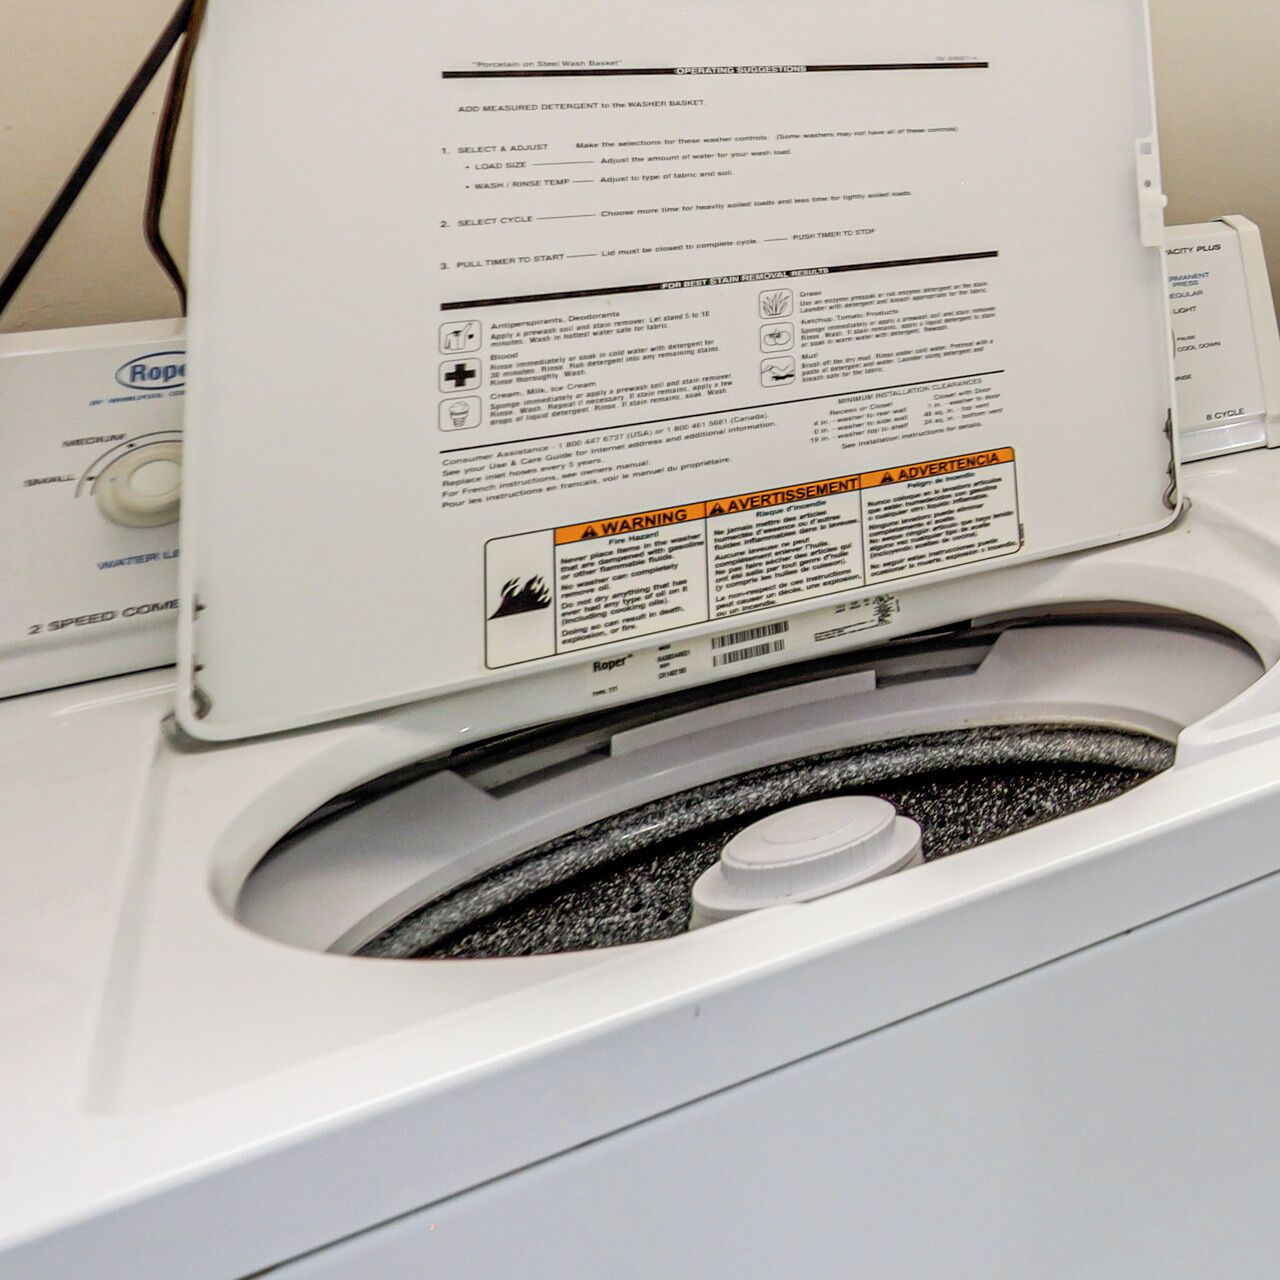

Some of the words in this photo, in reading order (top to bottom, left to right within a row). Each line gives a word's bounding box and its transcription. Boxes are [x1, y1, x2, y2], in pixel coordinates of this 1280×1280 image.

[676, 67, 734, 75] OPERATING
[737, 65, 807, 73] SUGGESTIONS
[457, 145, 497, 154] SELECT
[509, 143, 548, 151] ADJUST
[474, 162, 503, 170] LOAD
[505, 161, 526, 169] SIZE
[543, 178, 570, 186] TEMP
[457, 217, 497, 227] SELECT
[499, 215, 533, 224] CYCLE
[1165, 247, 1194, 255] ACITY
[1196, 243, 1222, 252] PLUS
[456, 260, 483, 268] PULL
[485, 257, 516, 265] TIMER
[533, 253, 564, 262] START
[662, 281, 681, 290] FOR
[684, 279, 707, 288] BEST
[710, 276, 739, 285] STAIN
[742, 271, 790, 282] REMOVAL
[1172, 280, 1199, 288] PRESS
[1172, 305, 1197, 315] LIGHT
[1198, 341, 1221, 349] DOWN
[489, 352, 519, 361] Blood
[1214, 408, 1245, 419] CYCLE
[441, 454, 493, 466] Consumer
[496, 446, 549, 458] Assistance
[441, 476, 482, 487] Replace
[485, 472, 506, 480] inlet
[508, 468, 537, 476] hoses
[540, 463, 566, 472] every
[576, 458, 602, 468] years.
[898, 452, 1000, 481] ADVERTENCIA
[728, 477, 858, 511] AVERTISSEMENT
[602, 509, 687, 534] WARNING
[628, 530, 659, 542] Hazard
[97, 552, 159, 570] WATER
[28, 625, 42, 635] 2
[48, 610, 118, 632] SPEED
[593, 657, 627, 672] Roper
